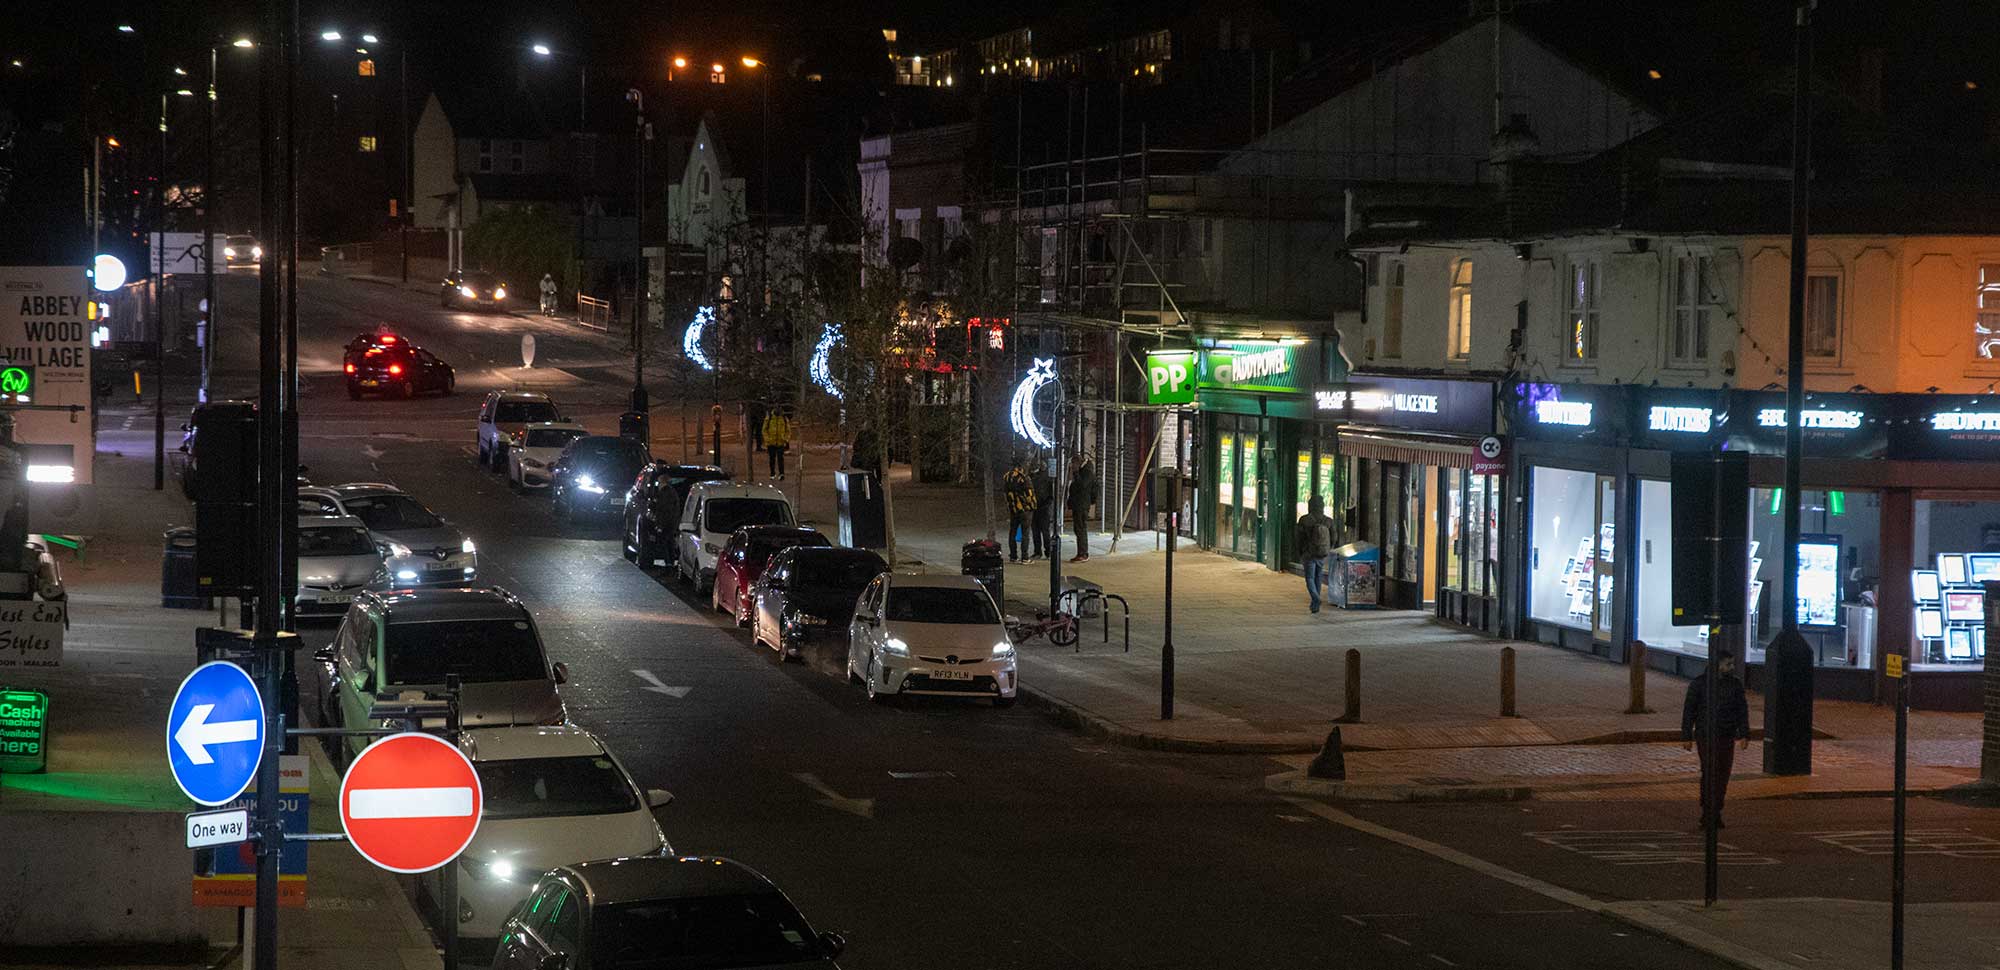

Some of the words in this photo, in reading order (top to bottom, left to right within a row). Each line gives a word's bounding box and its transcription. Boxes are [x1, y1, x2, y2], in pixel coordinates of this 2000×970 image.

[20, 295, 81, 316] ABBEY
[24, 321, 83, 342] WOOD
[1649, 406, 1713, 432] HUNTERS
[1475, 463, 1506, 472] payzone
[0, 609, 24, 623] est
[33, 603, 62, 623] End
[0, 630, 50, 655] Styles
[0, 703, 41, 719] Cash
[0, 718, 41, 728] machine
[0, 729, 40, 739] Available
[0, 738, 39, 753] here
[192, 823, 216, 838] One
[220, 821, 243, 835] way
